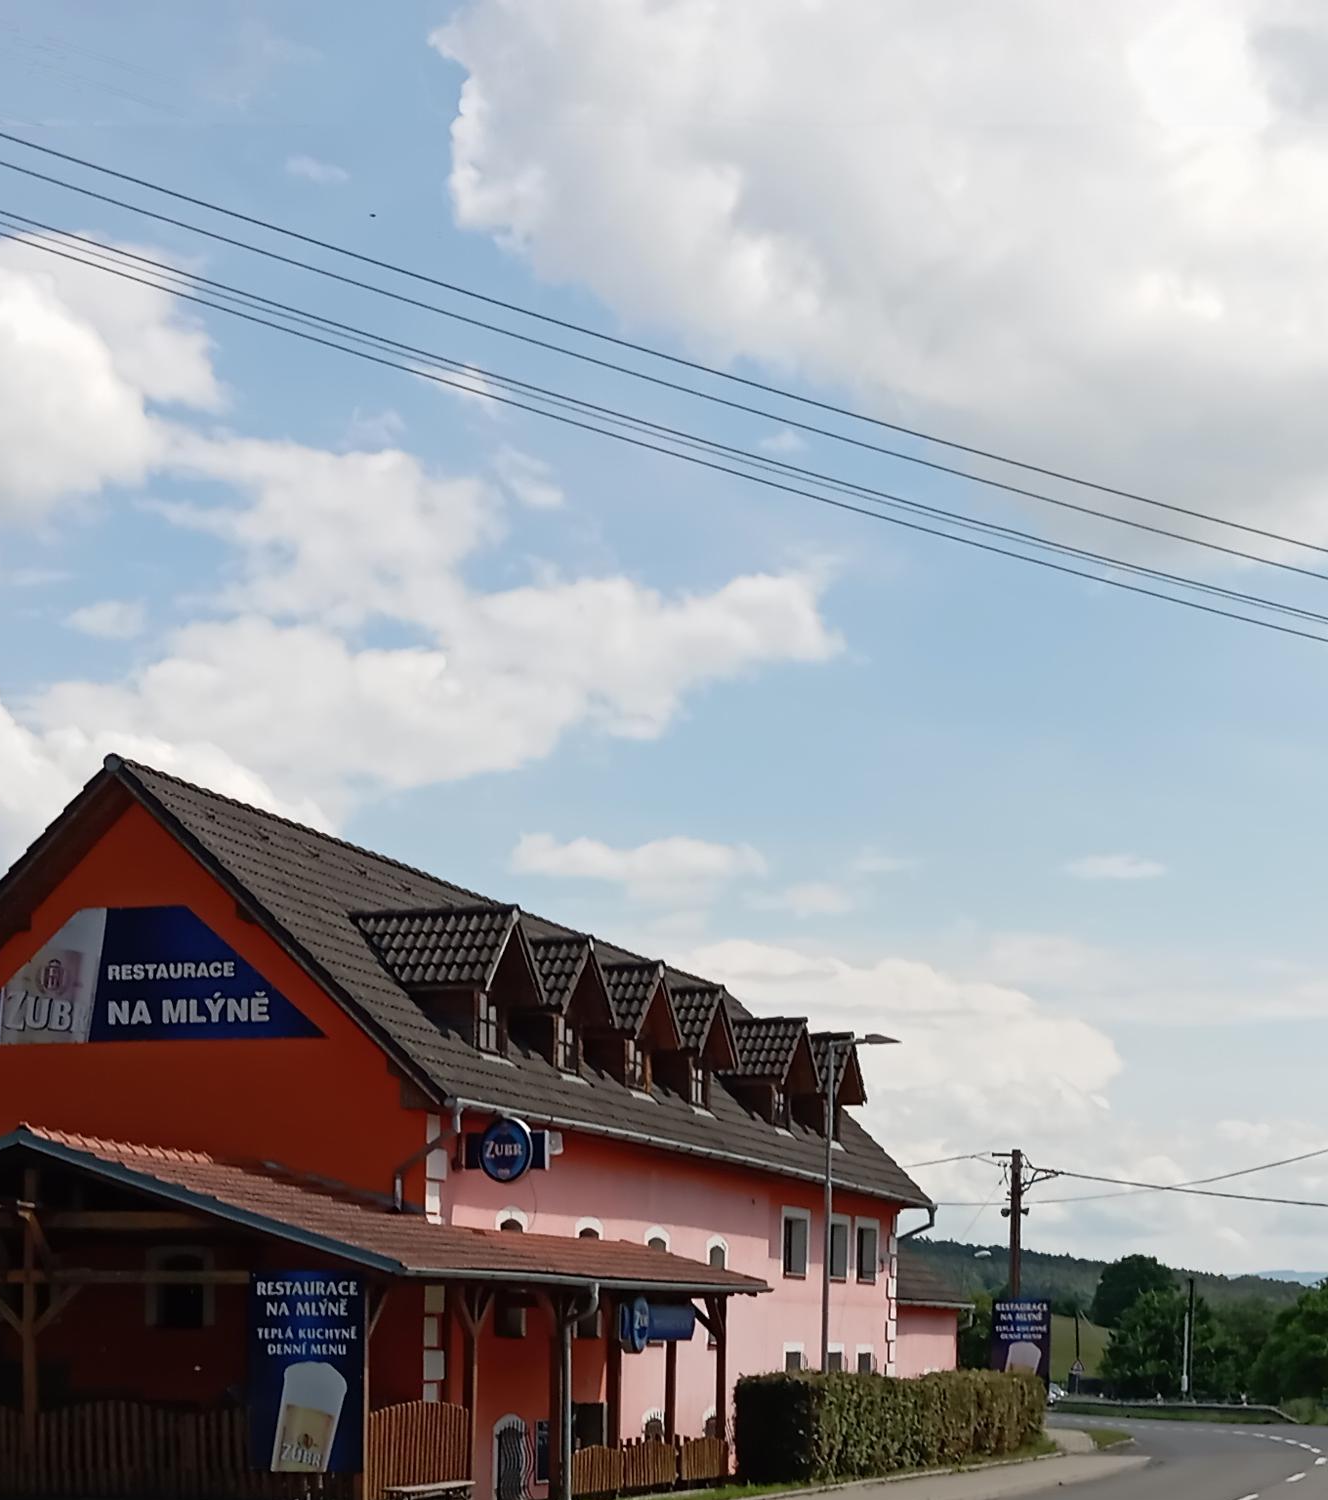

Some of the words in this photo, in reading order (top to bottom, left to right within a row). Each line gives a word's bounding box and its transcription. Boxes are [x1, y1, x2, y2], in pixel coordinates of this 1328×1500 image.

[107, 961, 235, 981] RESTAURACE
[107, 1000, 152, 1025] NA
[162, 991, 270, 1024] MLÝNĚ
[256, 1281, 358, 1296] RESTAURACE
[266, 1301, 290, 1317] NA
[295, 1298, 348, 1317] MLÝNĚ
[257, 1326, 293, 1340] TEPLÁ
[267, 1341, 307, 1356] DENNÍ
[310, 1343, 347, 1356] MENU
